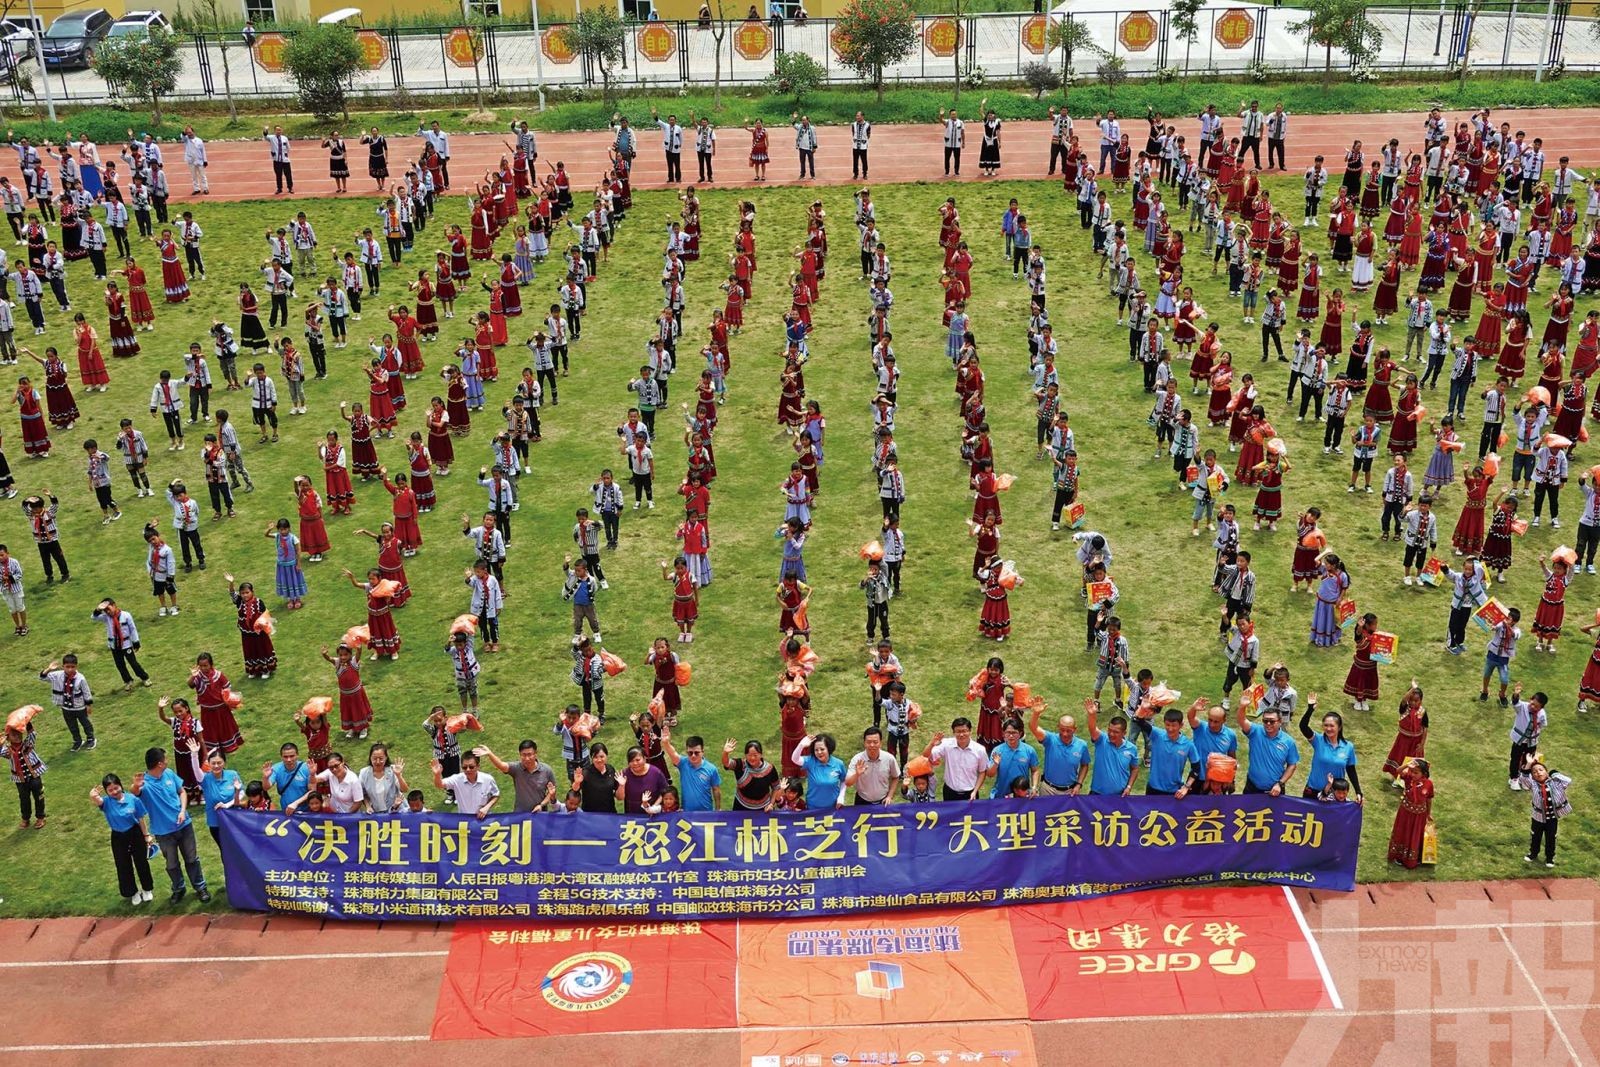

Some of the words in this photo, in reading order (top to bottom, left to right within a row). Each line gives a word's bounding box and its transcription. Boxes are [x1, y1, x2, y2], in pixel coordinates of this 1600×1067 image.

[646, 33, 669, 51] 自由
[743, 31, 765, 49] 平等
[445, 871, 699, 885] 人民日报粤港澳大湾区融媒体工作室
[707, 865, 867, 882] 珠海市妇女儿童福利会
[537, 902, 650, 916] 珠海路虎俱乐部
[656, 898, 815, 915] 中国邮政珠海市分公司
[1067, 921, 1248, 950] 格力集团
[788, 935, 960, 957] 珠海传媒集团
[1078, 953, 1201, 975] GREE
